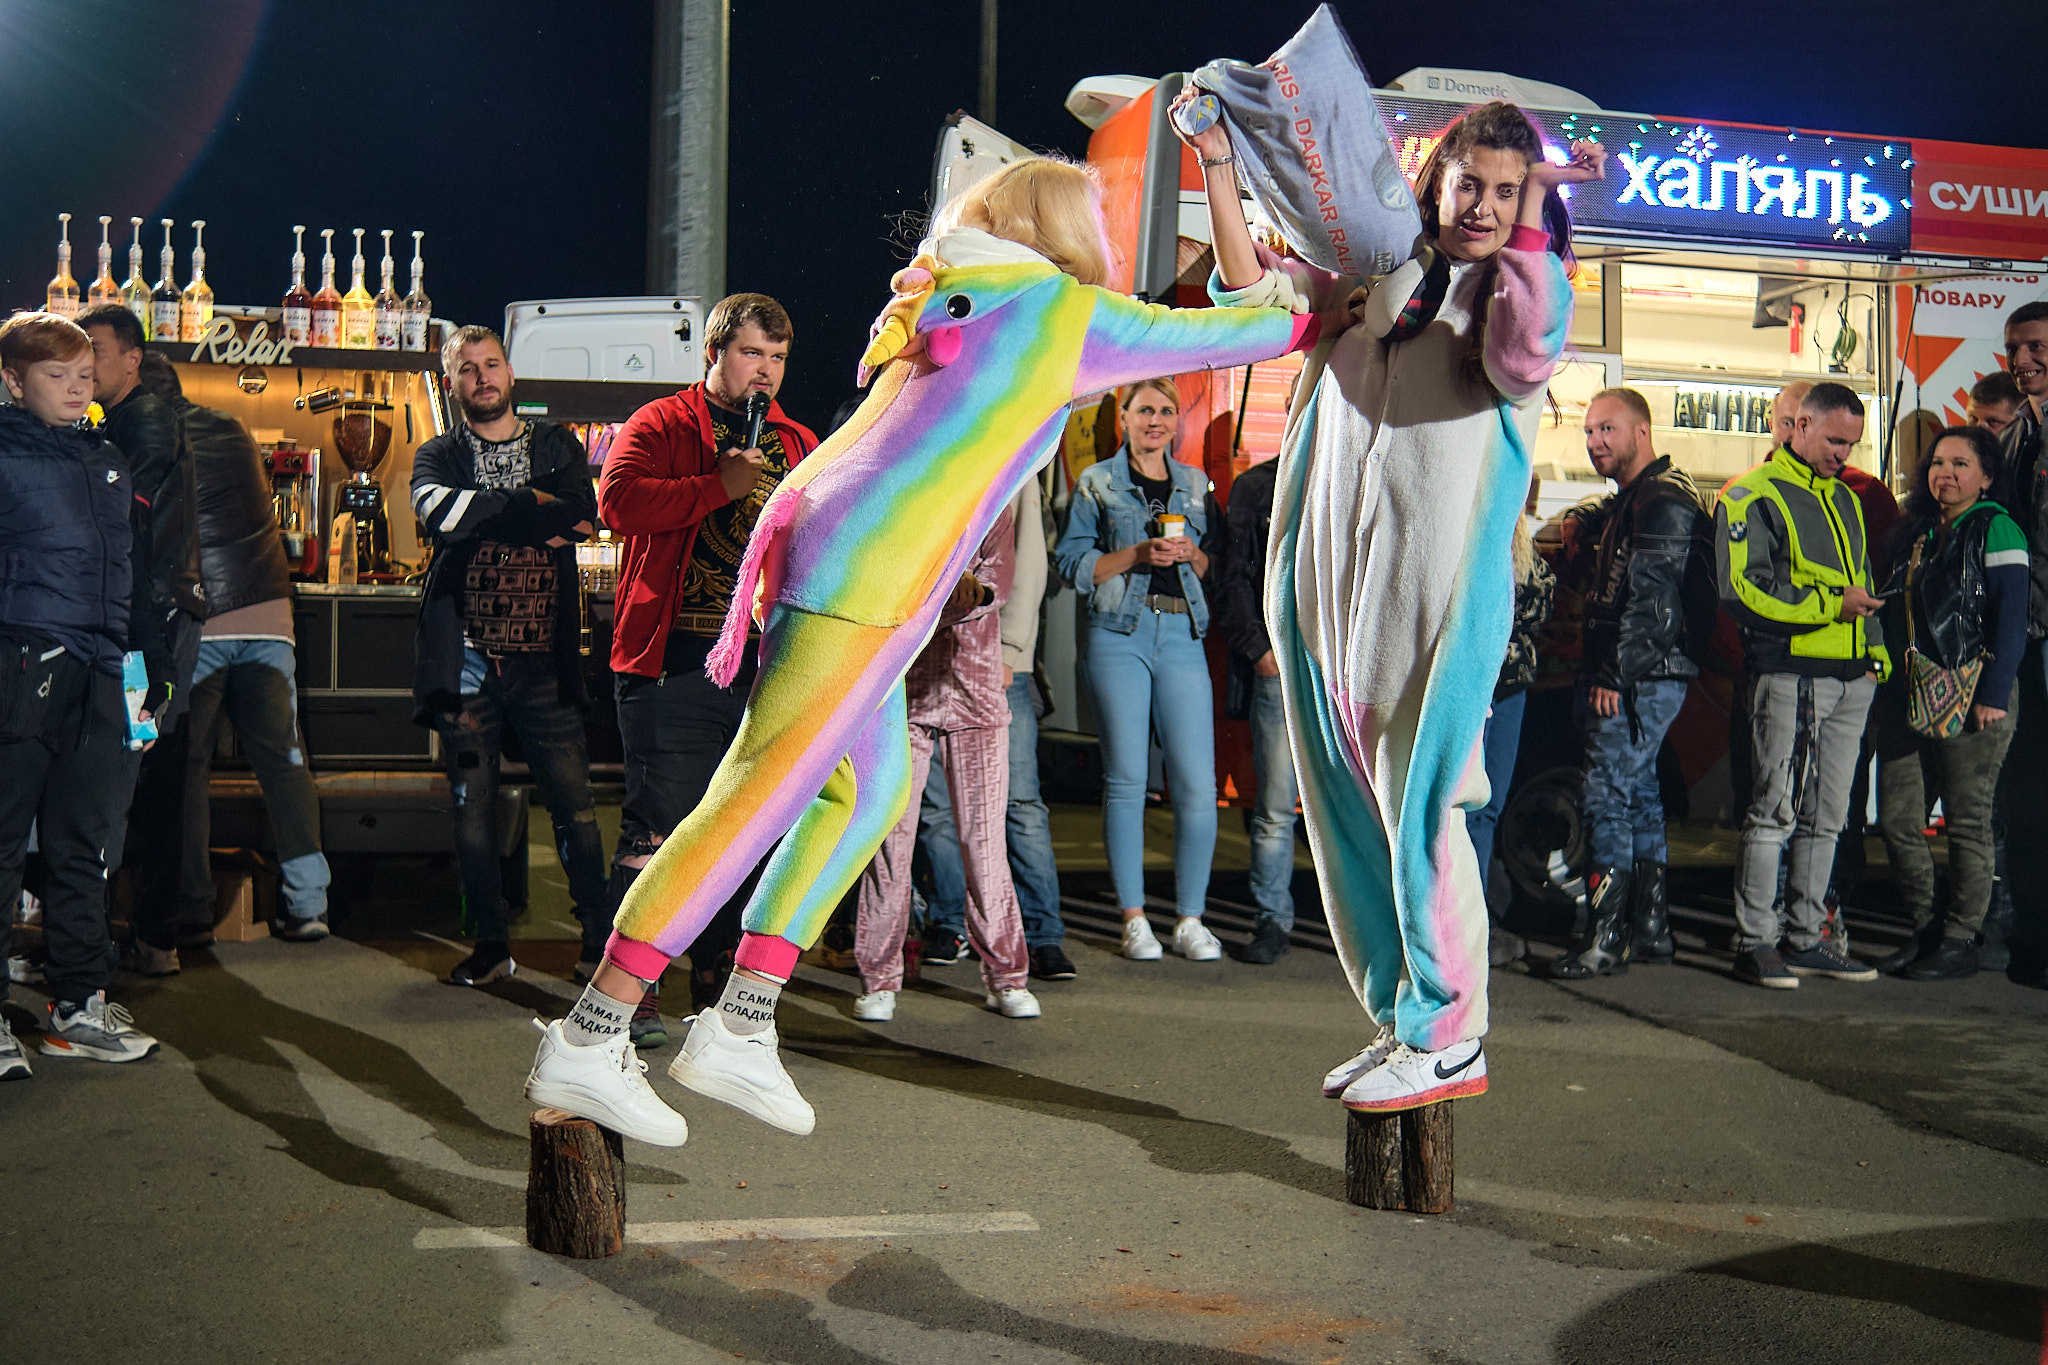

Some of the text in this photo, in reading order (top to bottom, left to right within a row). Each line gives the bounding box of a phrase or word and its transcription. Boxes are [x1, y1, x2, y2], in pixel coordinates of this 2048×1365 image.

[1444, 77, 1510, 99] Dometic
[1294, 117, 1340, 224] DARKAR
[1917, 288, 2007, 309] ПОВАРУ
[190, 315, 295, 365] Relax
[570, 1009, 622, 1035] ЛАДКАЯ
[579, 998, 622, 1024] САМАЯ
[723, 1002, 773, 1023] СЛАДКА
